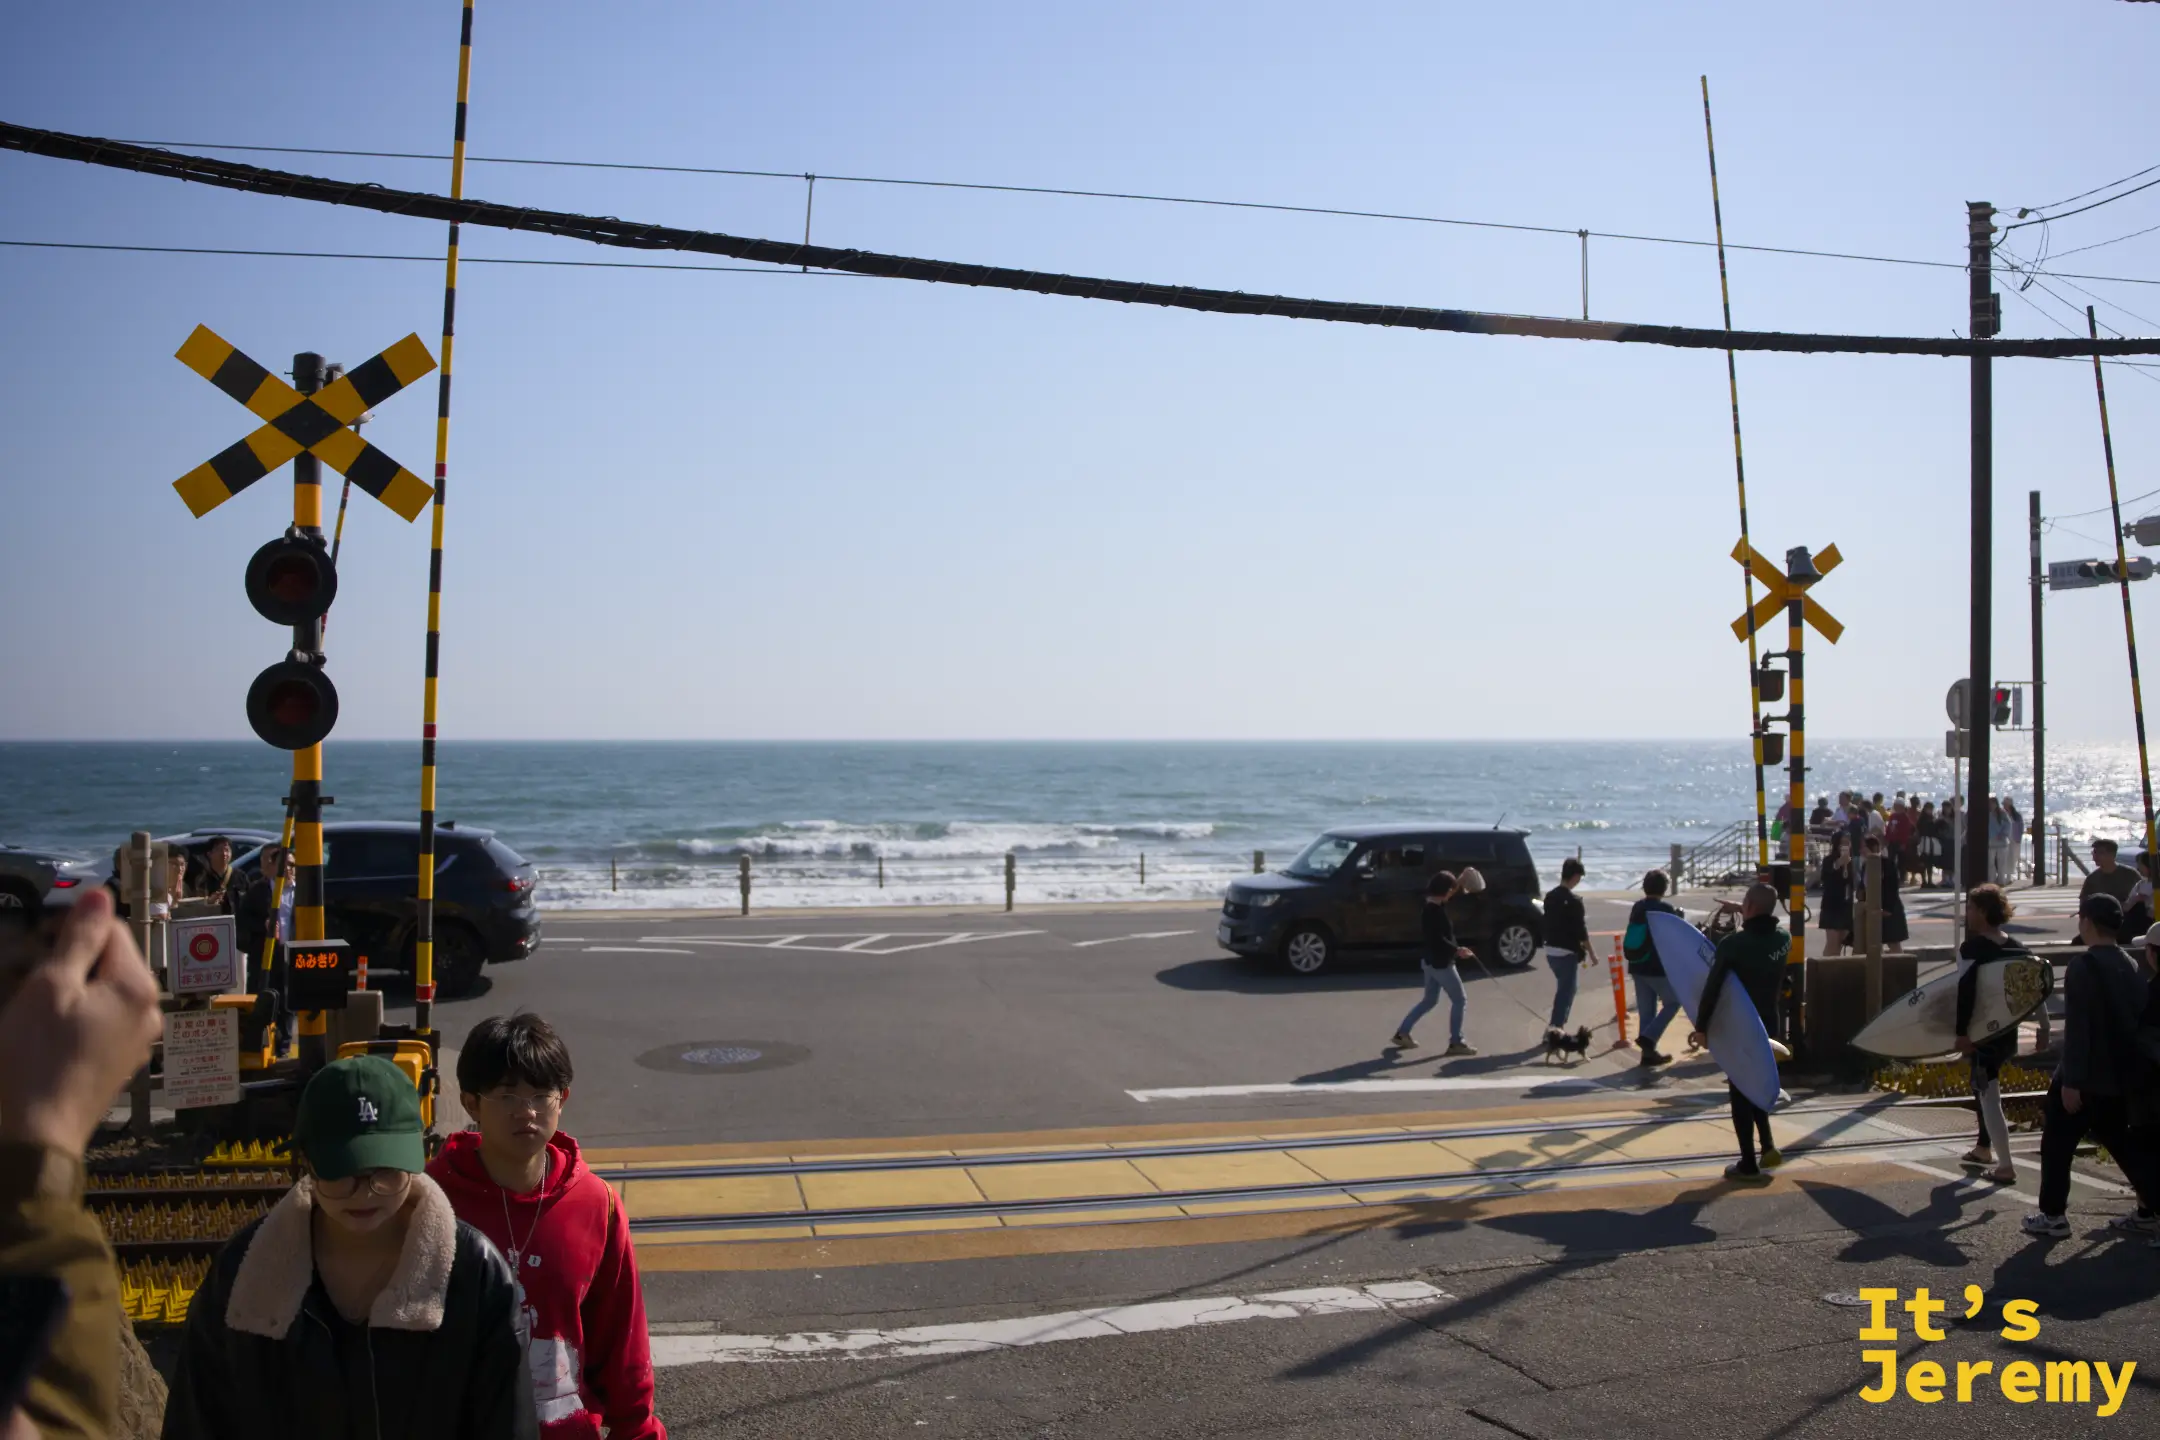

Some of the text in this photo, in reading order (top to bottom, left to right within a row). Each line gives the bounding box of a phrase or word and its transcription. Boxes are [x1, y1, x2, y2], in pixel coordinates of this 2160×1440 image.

[295, 952, 339, 969] ふみきり
[357, 1096, 379, 1122] LA
